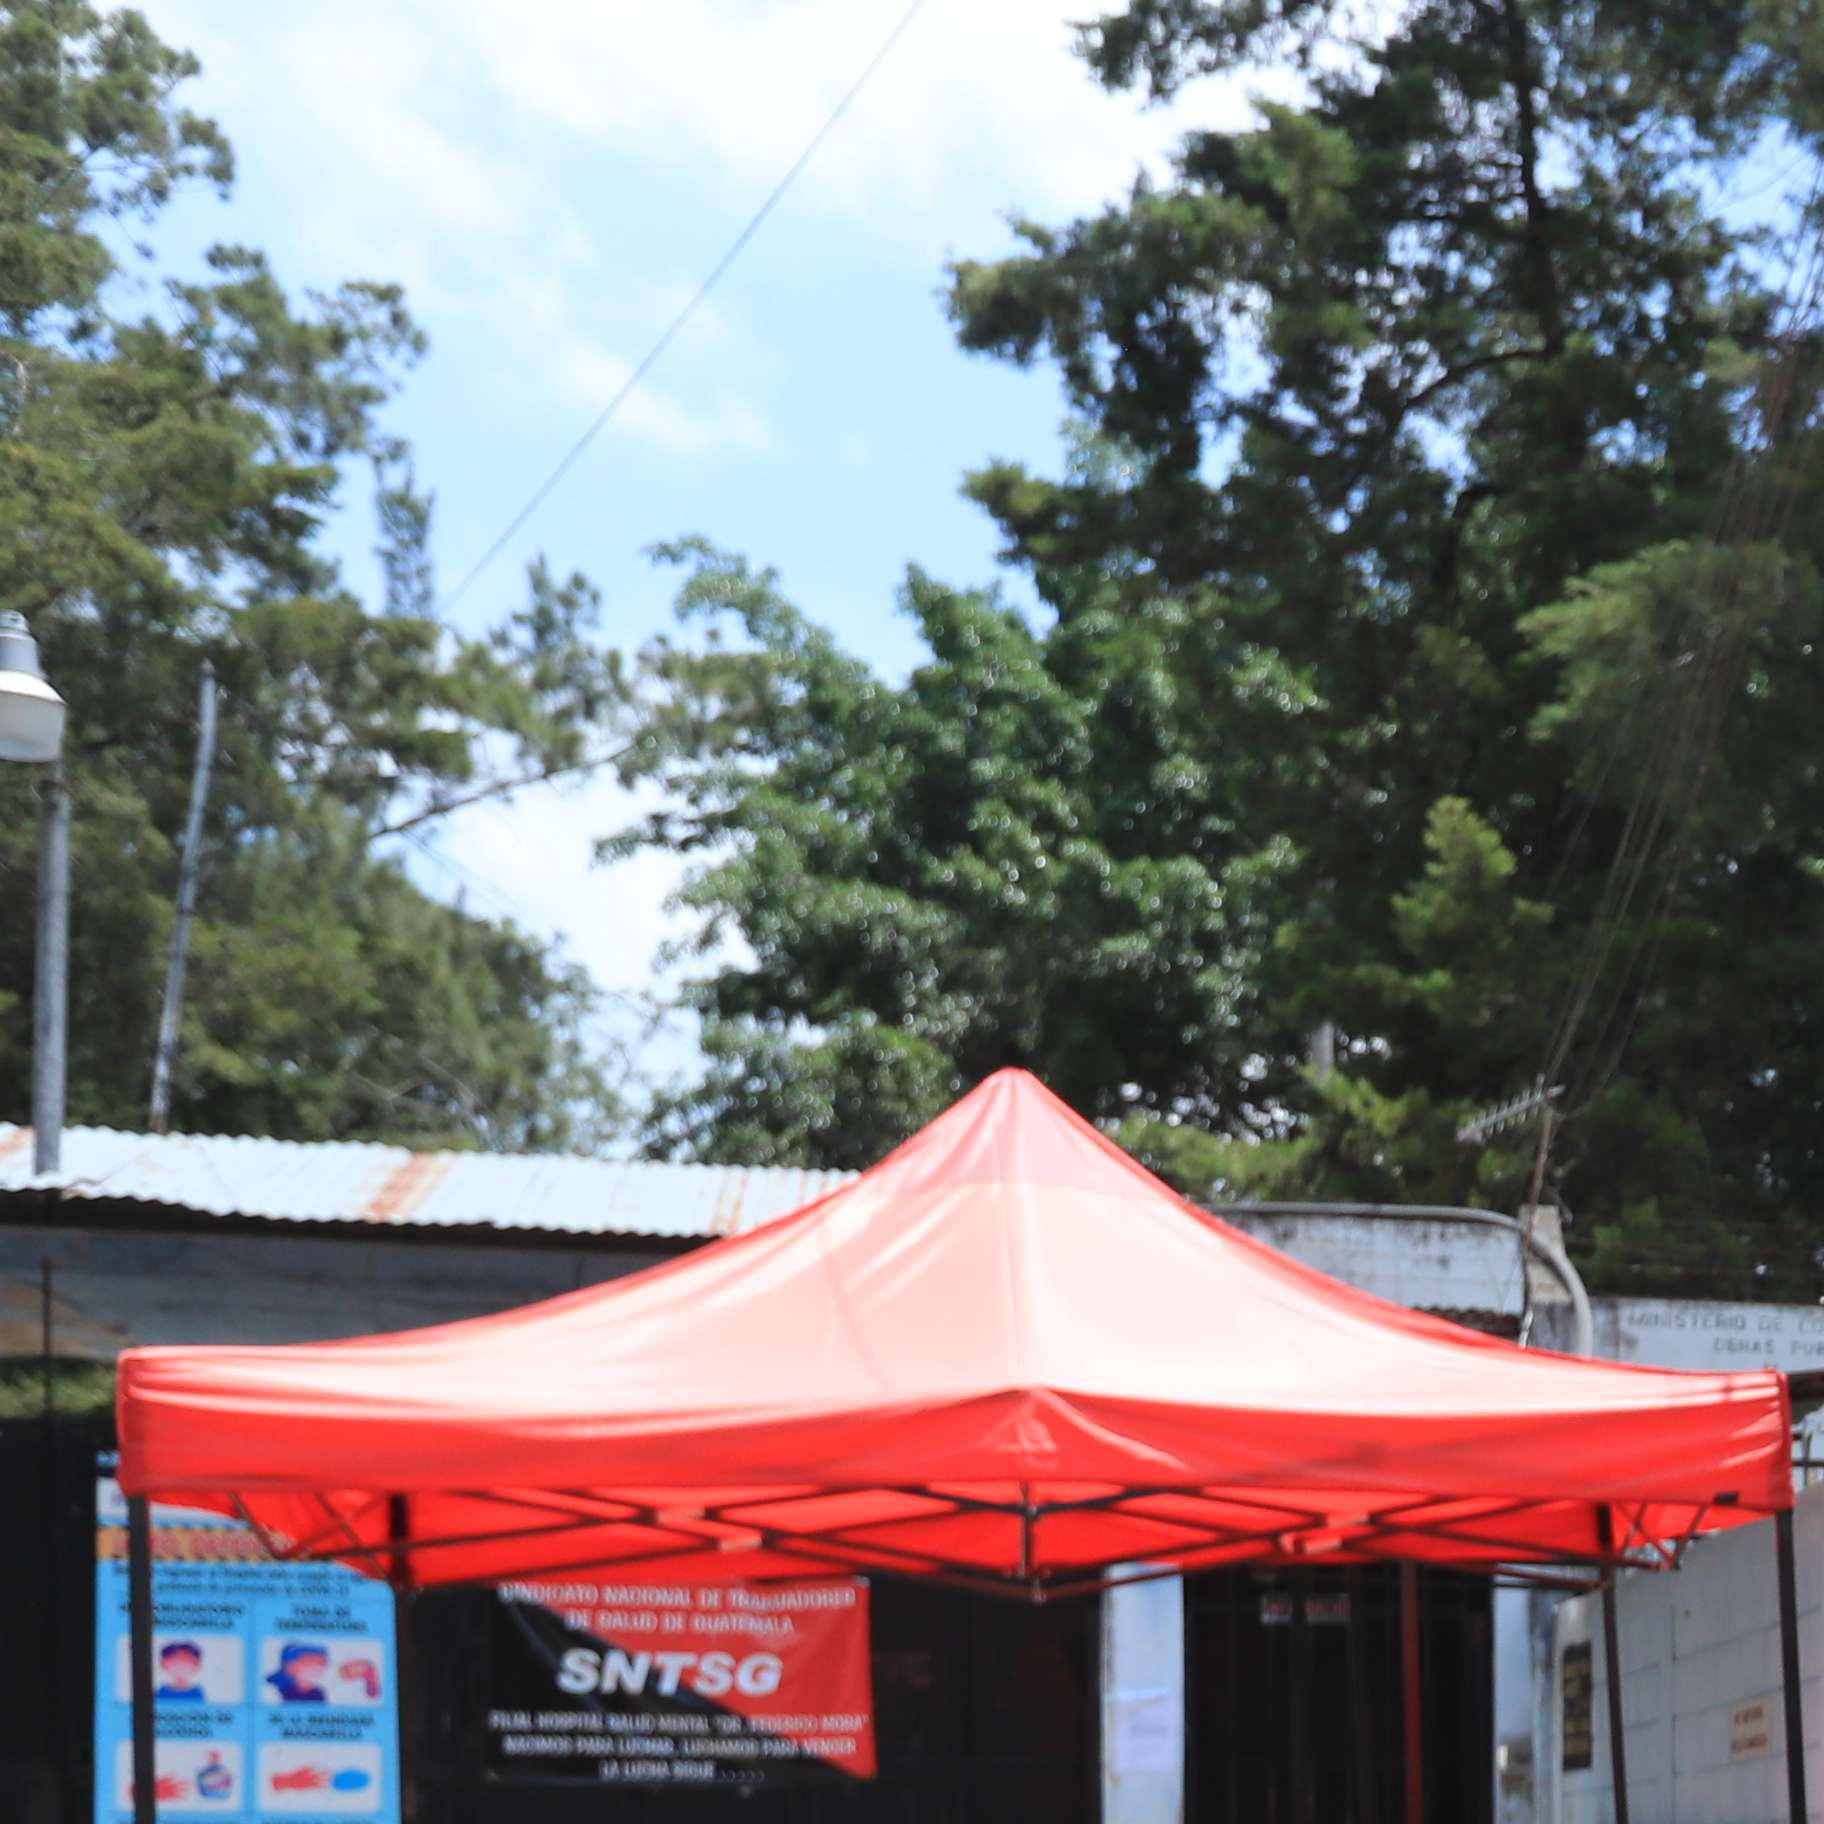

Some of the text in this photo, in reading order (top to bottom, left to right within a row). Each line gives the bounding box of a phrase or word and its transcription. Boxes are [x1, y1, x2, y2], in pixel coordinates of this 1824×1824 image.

[498, 1581, 599, 1604] SINDICATO
[604, 1585, 692, 1607] NACIONAL
[699, 1587, 724, 1608] DE
[564, 1609, 795, 1635] DE SALUD DE GUATEMALA
[556, 1646, 784, 1697] SNTSG
[537, 1710, 605, 1732] HOSPITAL
[606, 1712, 656, 1732] SALUD
[576, 1735, 615, 1757] PARA
[761, 1736, 800, 1757] PARA
